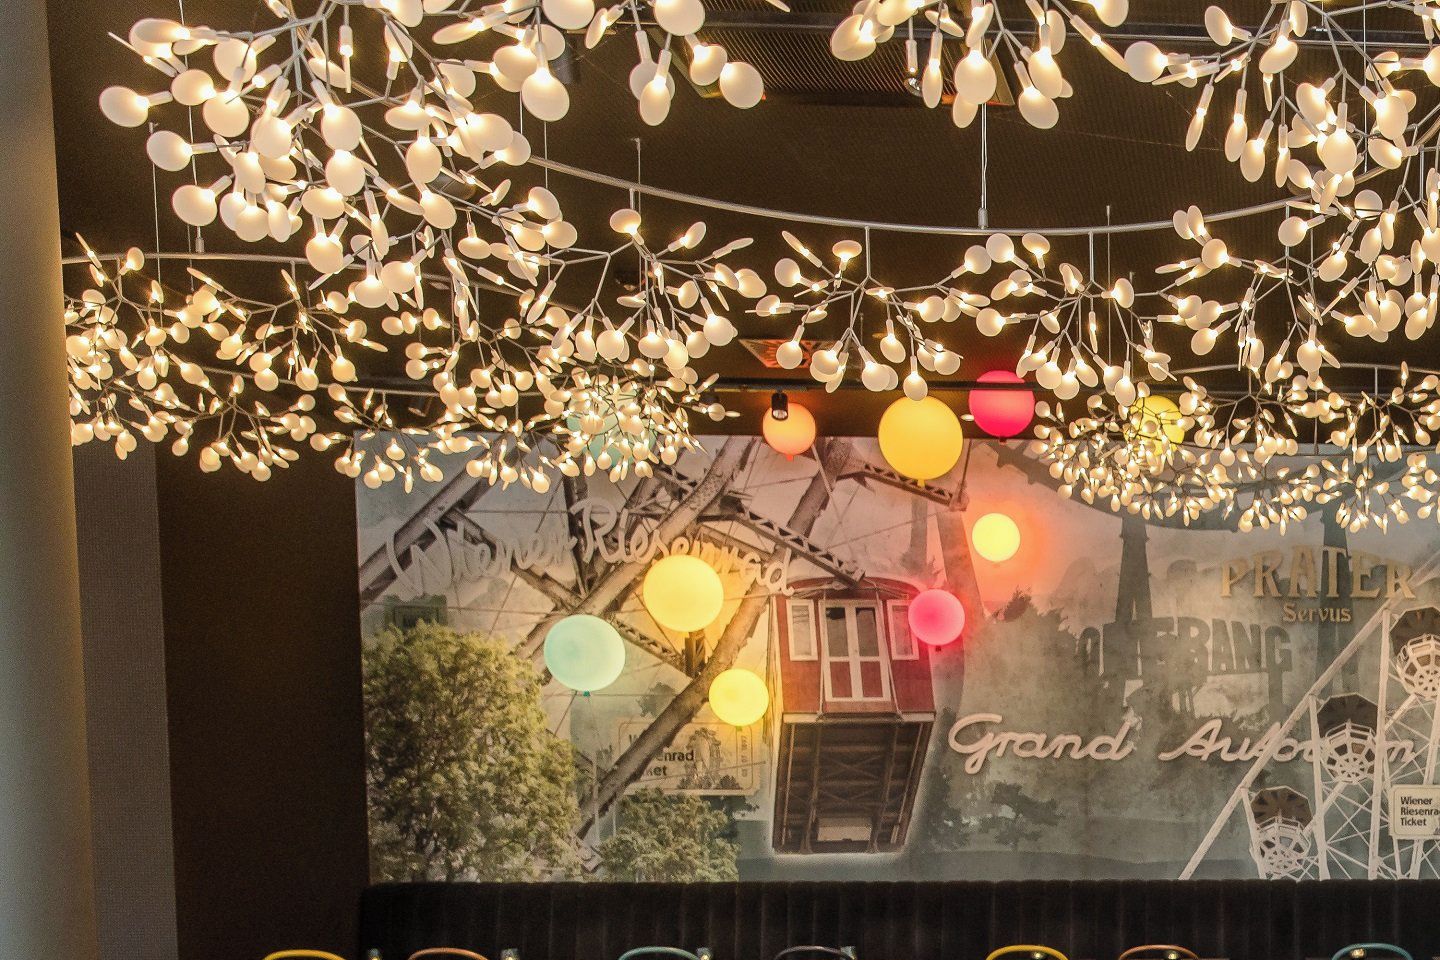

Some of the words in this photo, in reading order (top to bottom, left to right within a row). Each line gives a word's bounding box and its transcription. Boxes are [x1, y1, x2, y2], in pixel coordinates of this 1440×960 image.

[1219, 544, 1416, 600] PRATER
[1282, 602, 1352, 624] Servus
[948, 713, 1137, 775] Grand
[1400, 796, 1433, 805] Wiener
[1400, 817, 1427, 827] Ticket
